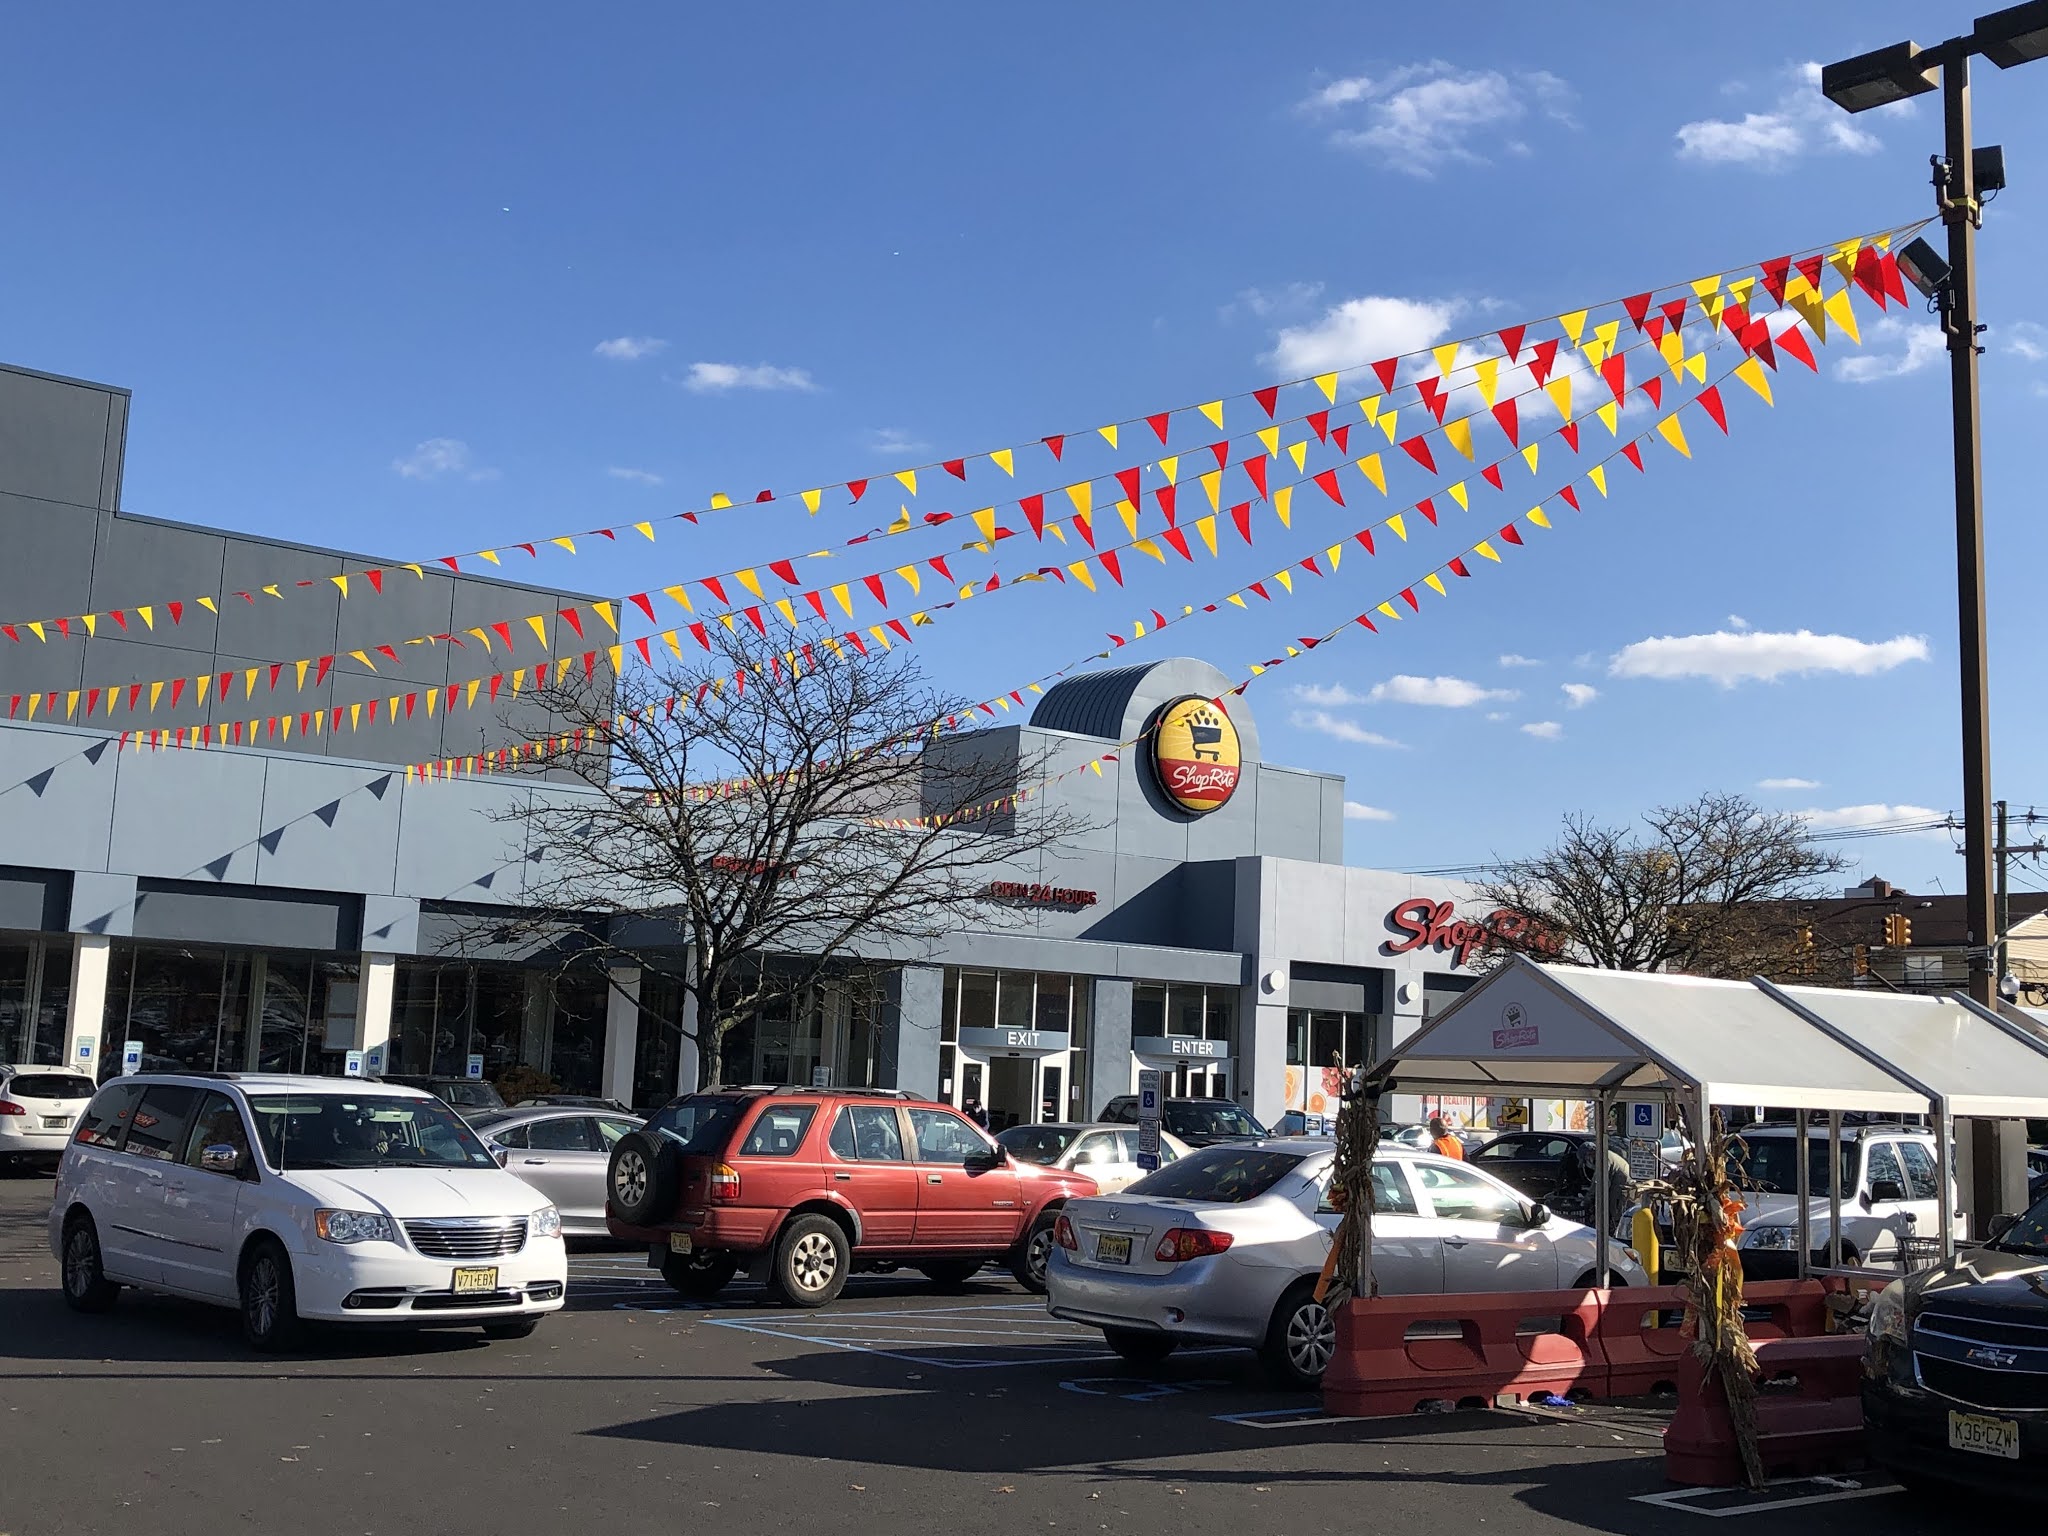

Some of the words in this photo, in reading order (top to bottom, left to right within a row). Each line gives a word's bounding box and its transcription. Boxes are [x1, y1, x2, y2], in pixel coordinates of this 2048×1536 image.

[1170, 765, 1235, 793] ShopRite
[990, 880, 1029, 897] OPEN
[1030, 883, 1051, 902] 24
[1053, 887, 1097, 905] HOURS
[1007, 1031, 1041, 1047] EXIT
[1171, 1040, 1214, 1055] ENTER
